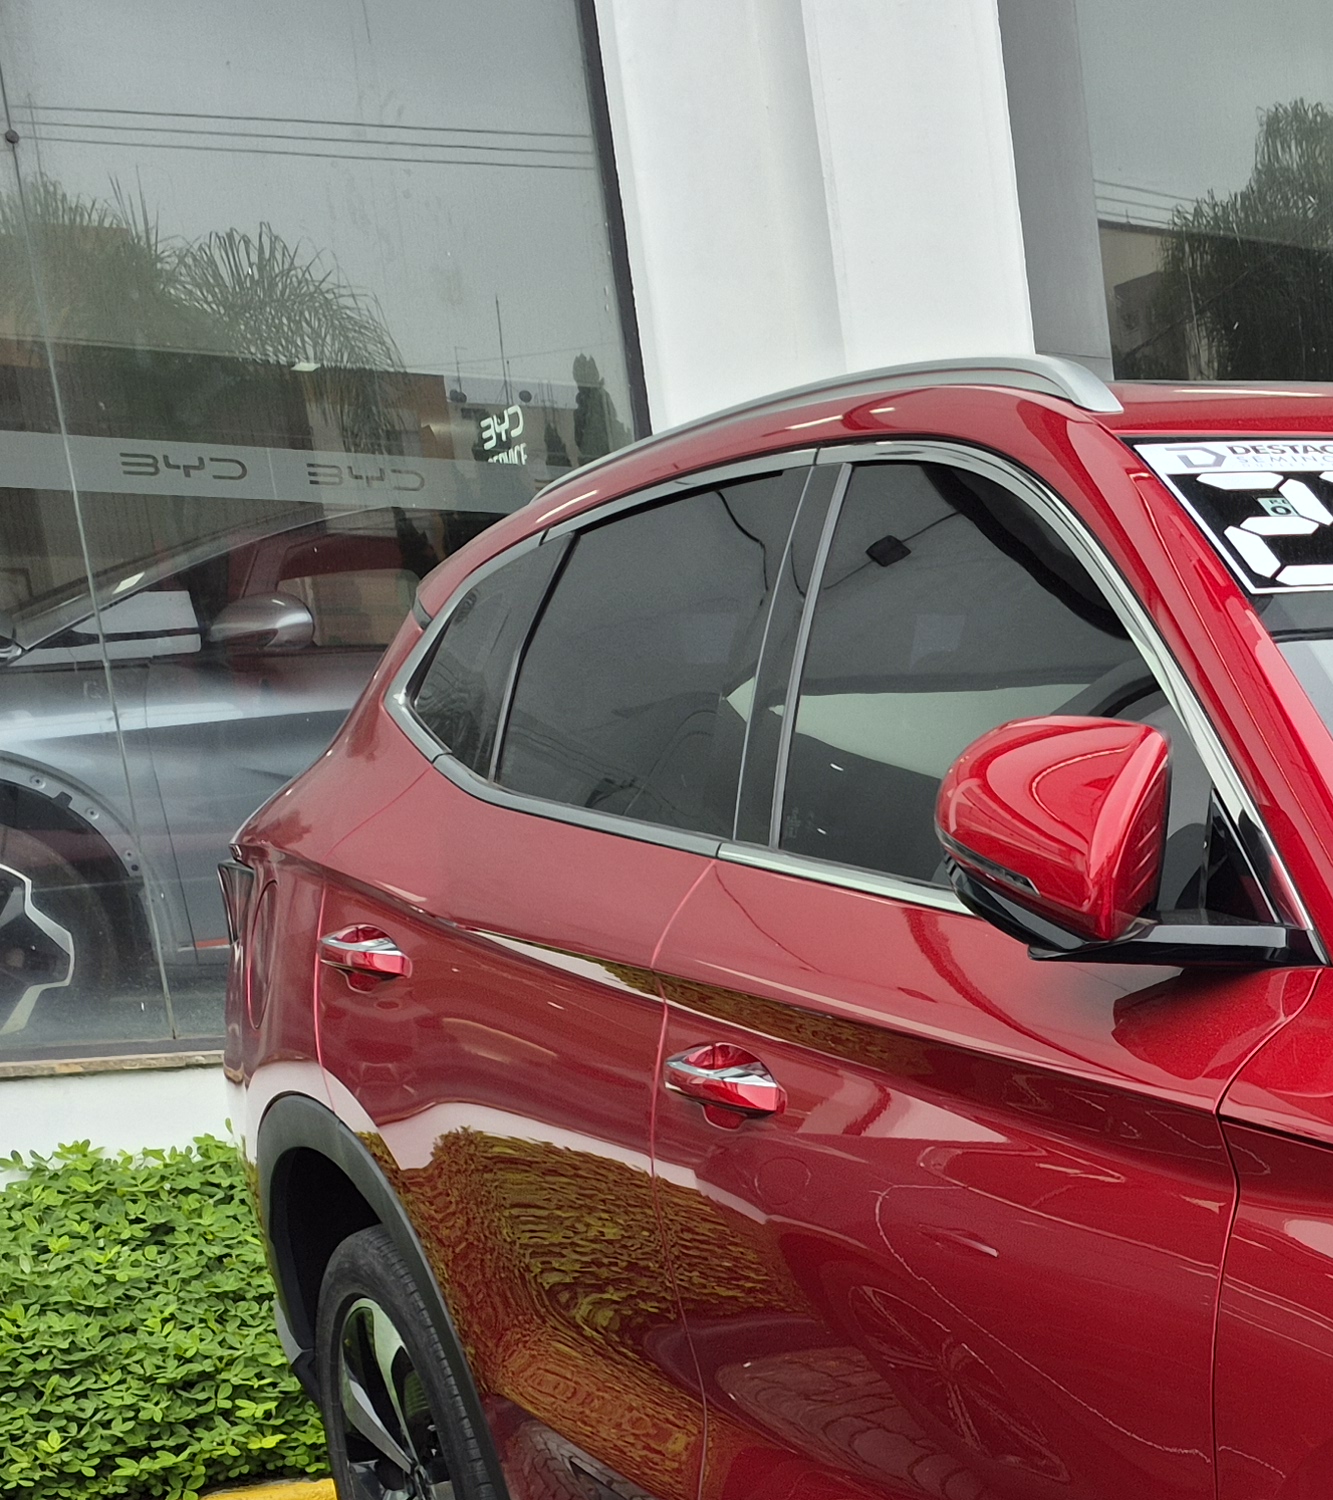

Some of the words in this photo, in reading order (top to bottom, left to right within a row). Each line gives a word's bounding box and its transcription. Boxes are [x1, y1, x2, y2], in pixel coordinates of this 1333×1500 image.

[480, 404, 524, 450] BYD
[119, 451, 248, 480] BYD
[306, 462, 425, 492] BYD
